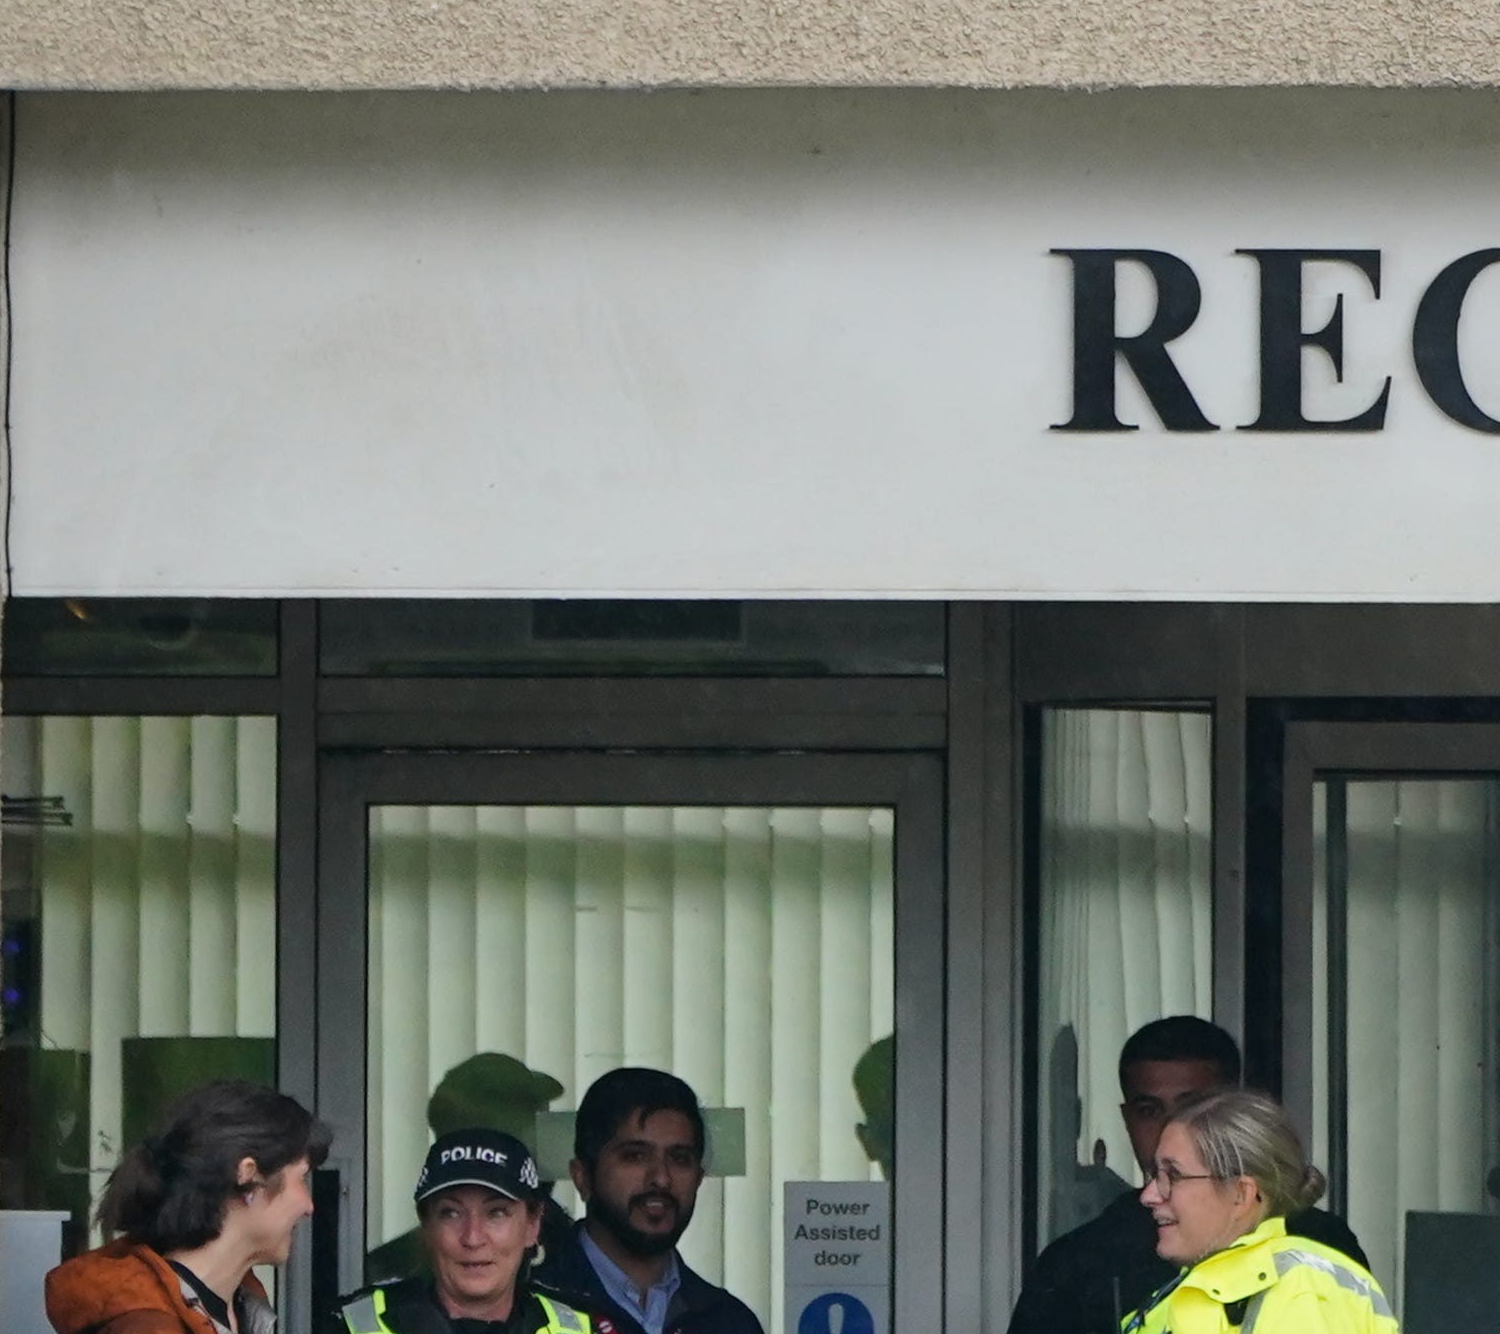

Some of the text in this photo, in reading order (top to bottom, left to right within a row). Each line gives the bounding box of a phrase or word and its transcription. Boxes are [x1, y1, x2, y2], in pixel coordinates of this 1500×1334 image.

[440, 1146, 509, 1166] POLICE
[806, 1199, 870, 1216] Power
[794, 1224, 881, 1241] Assisted
[813, 1250, 861, 1267] door
